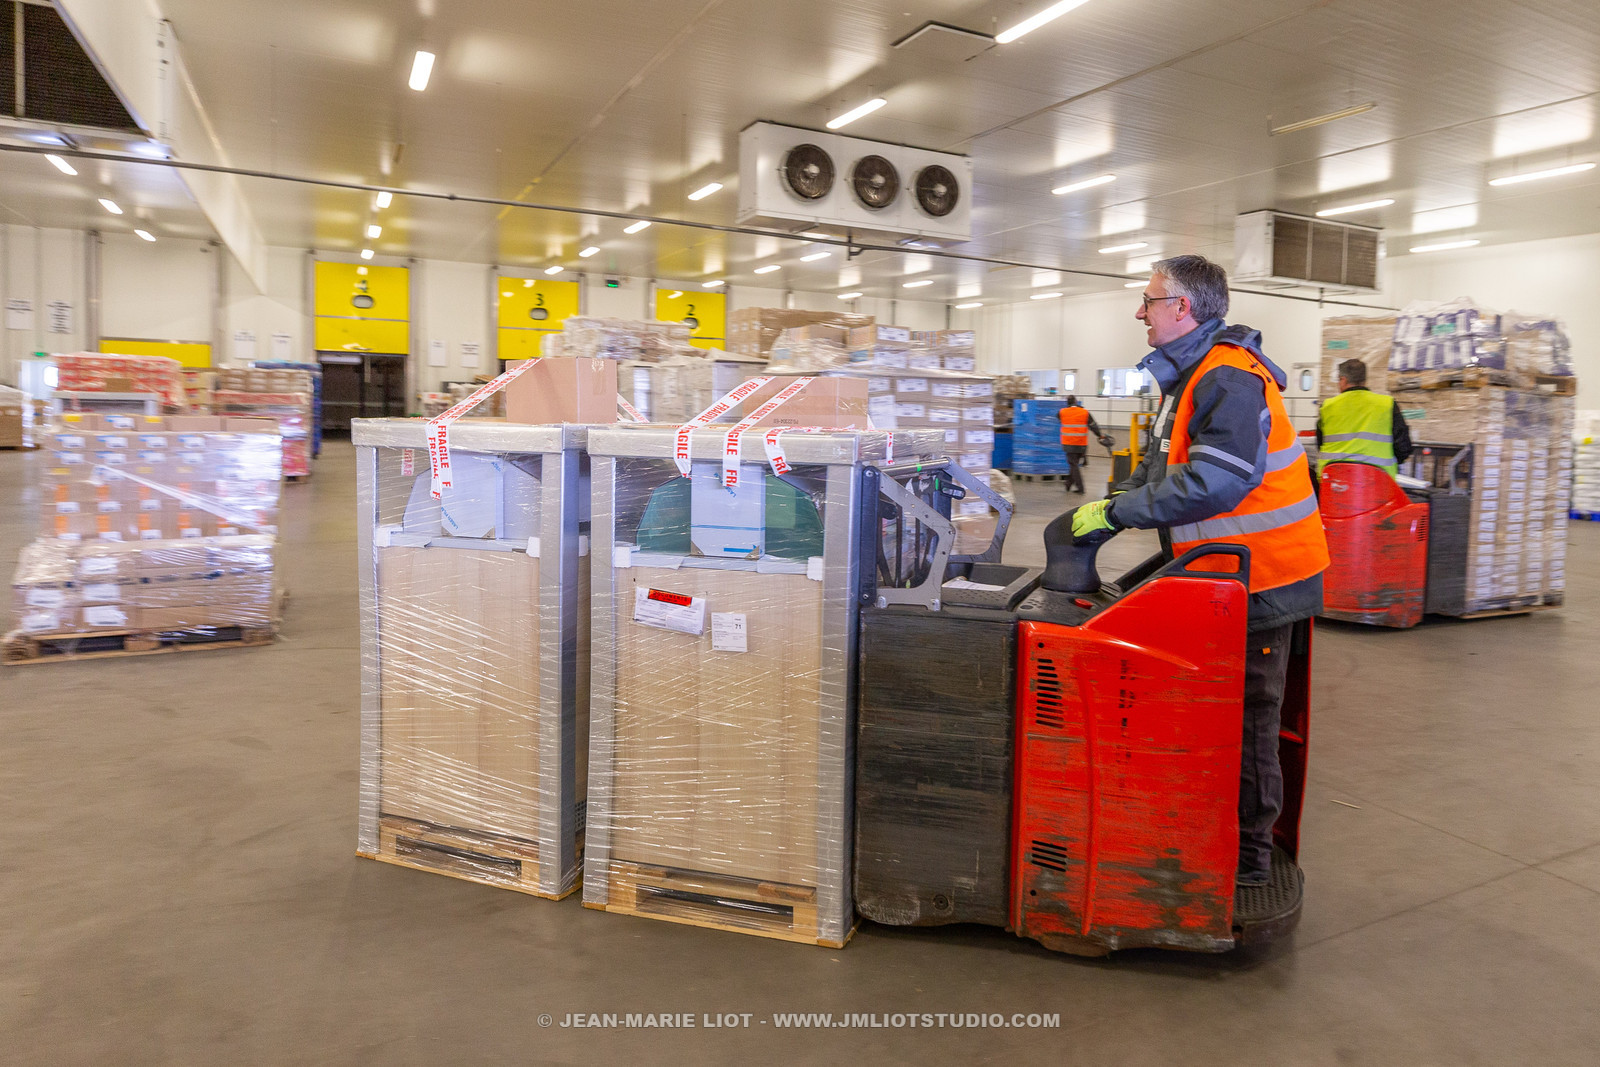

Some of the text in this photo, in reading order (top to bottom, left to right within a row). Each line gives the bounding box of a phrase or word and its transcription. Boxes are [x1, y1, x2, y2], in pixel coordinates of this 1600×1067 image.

[535, 292, 545, 306] 3
[686, 303, 696, 316] 2
[729, 381, 760, 402] FRAGILE
[775, 383, 804, 400] FRAGILE
[697, 402, 731, 423] FRAGILE
[747, 402, 779, 421] FRAGILE
[437, 424, 450, 469] FRAGILE
[726, 423, 751, 456] FRAGILE
